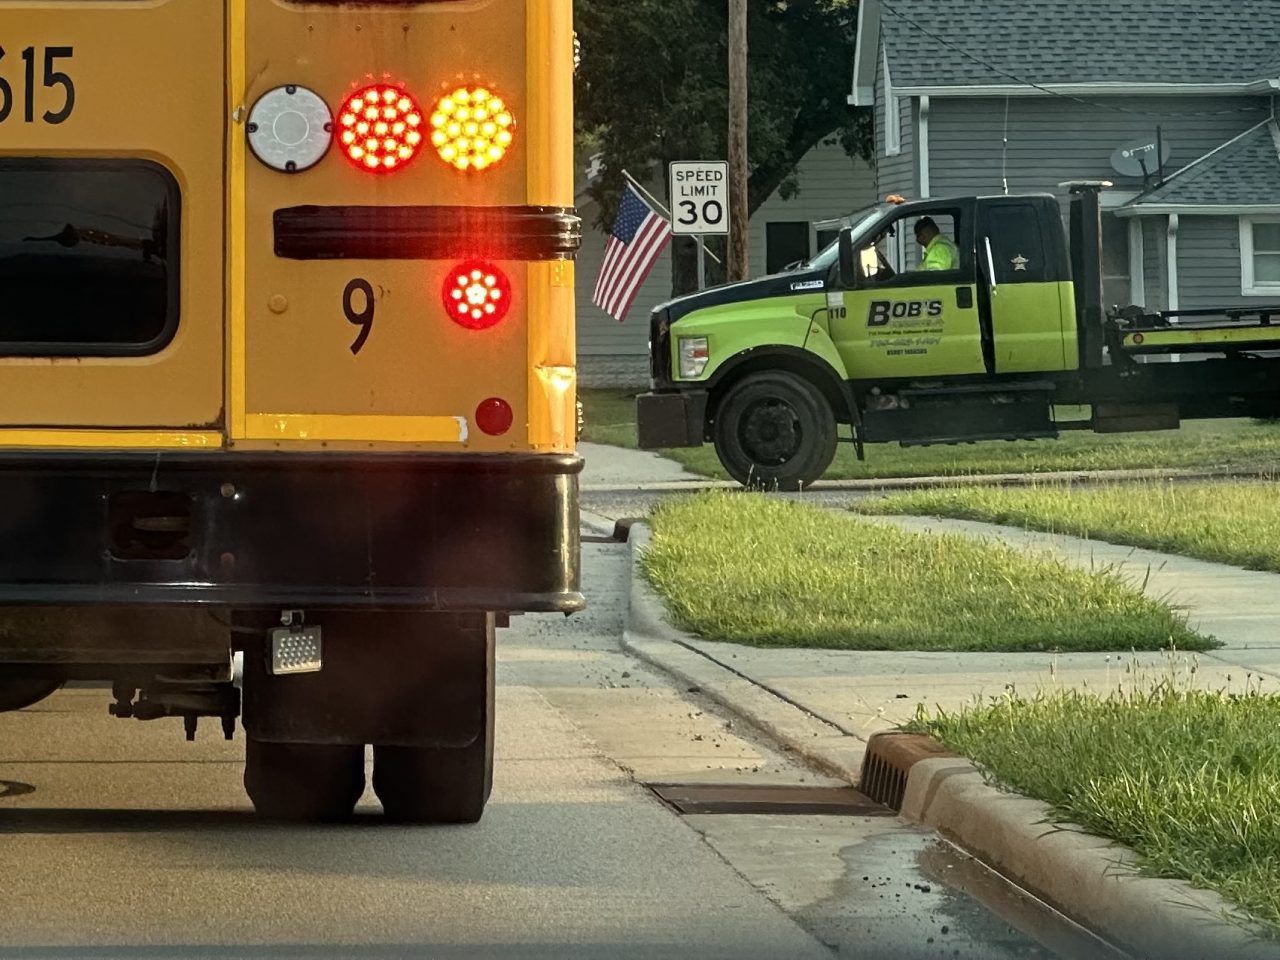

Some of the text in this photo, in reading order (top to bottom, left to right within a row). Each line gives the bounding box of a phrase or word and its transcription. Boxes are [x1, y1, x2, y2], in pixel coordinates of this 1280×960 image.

[676, 170, 723, 181] SPEED
[681, 185, 718, 196] LIMIT
[678, 200, 723, 225] 30
[342, 278, 376, 355] 9
[829, 307, 847, 319] 110
